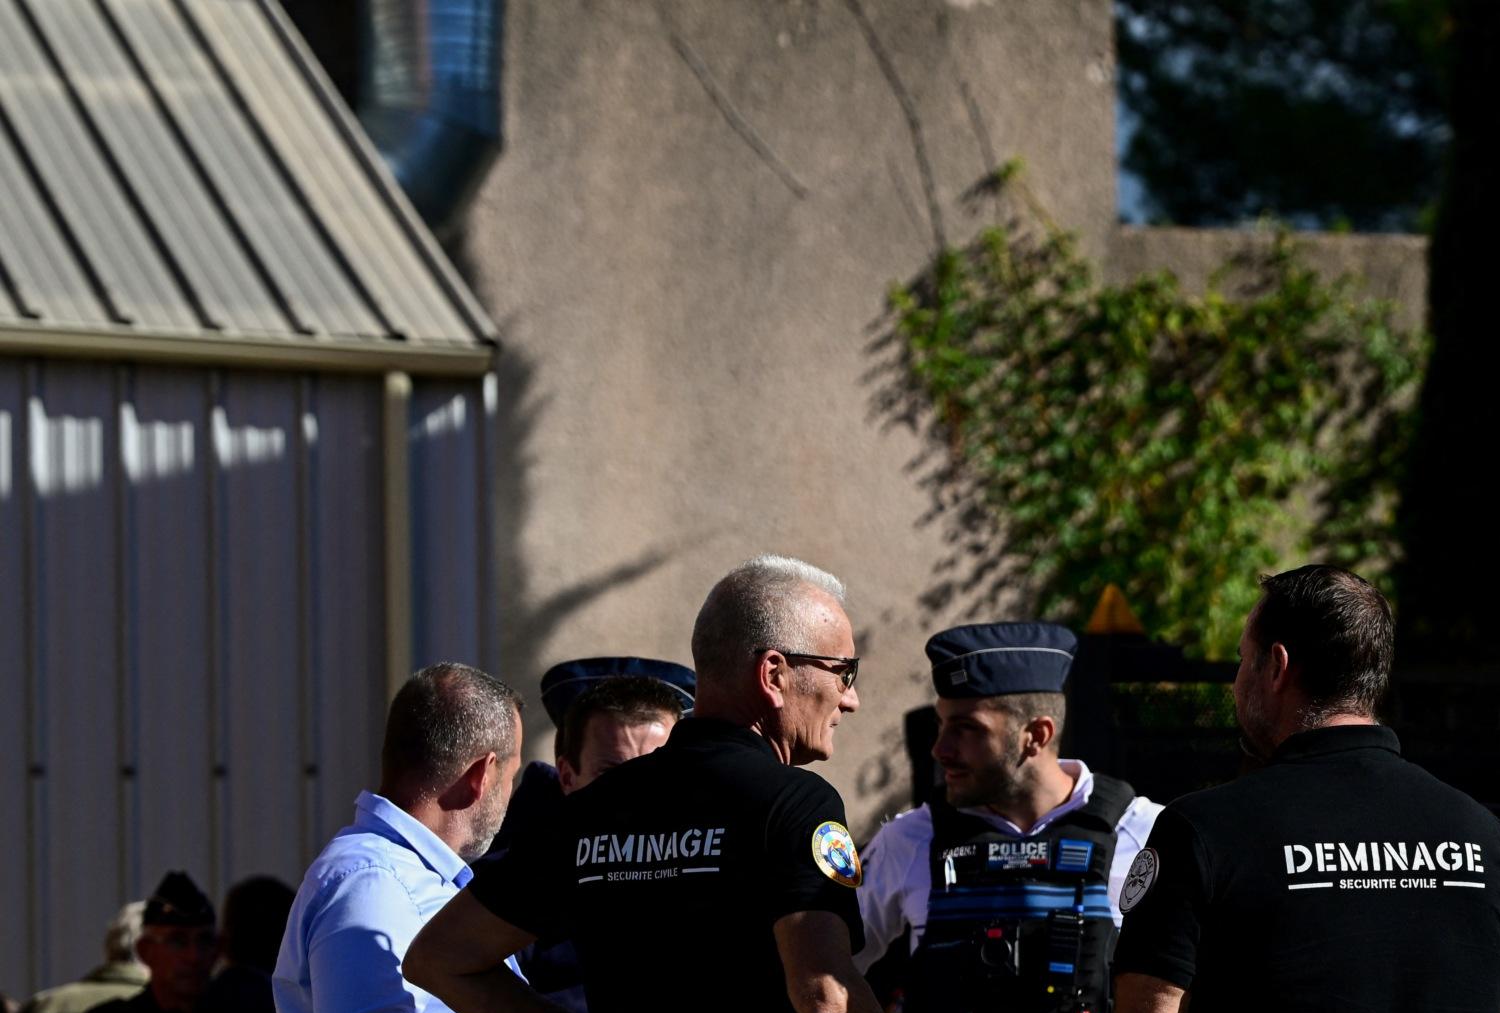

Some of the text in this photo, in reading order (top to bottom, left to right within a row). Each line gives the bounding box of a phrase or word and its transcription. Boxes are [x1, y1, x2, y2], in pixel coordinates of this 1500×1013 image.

[576, 828, 726, 867] DEMINAGE
[988, 842, 1048, 856] POLICE
[1284, 841, 1485, 875] DEMINAGE
[608, 868, 678, 882] SECURITE CIVILE
[1339, 878, 1437, 889] SECURITE CIVILE
